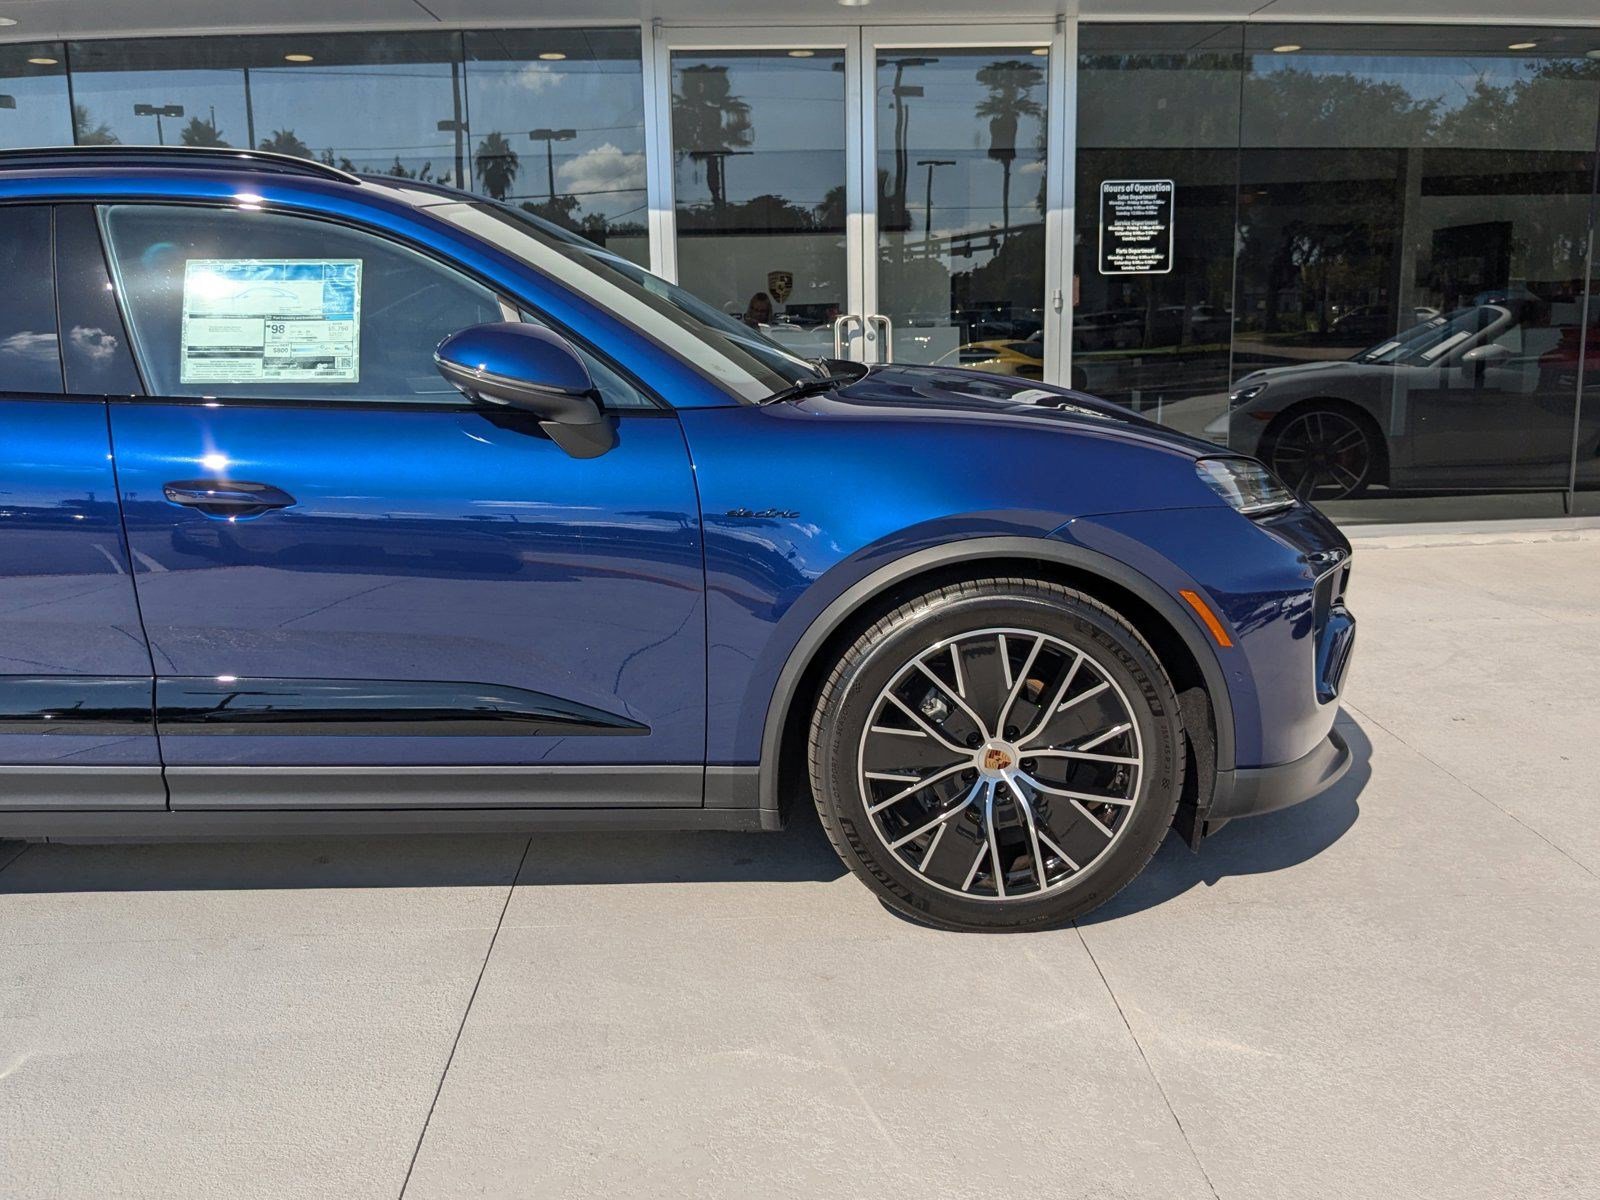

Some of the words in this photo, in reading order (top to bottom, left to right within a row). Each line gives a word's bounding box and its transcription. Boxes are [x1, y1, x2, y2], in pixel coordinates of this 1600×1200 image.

[1104, 184, 1124, 192] Hours
[1126, 184, 1133, 192] of
[1135, 184, 1170, 194] Operation
[271, 325, 285, 334] 98
[1095, 628, 1162, 712] MICHELIN
[832, 739, 840, 754] ALL
[840, 819, 910, 900] MICHELIN
